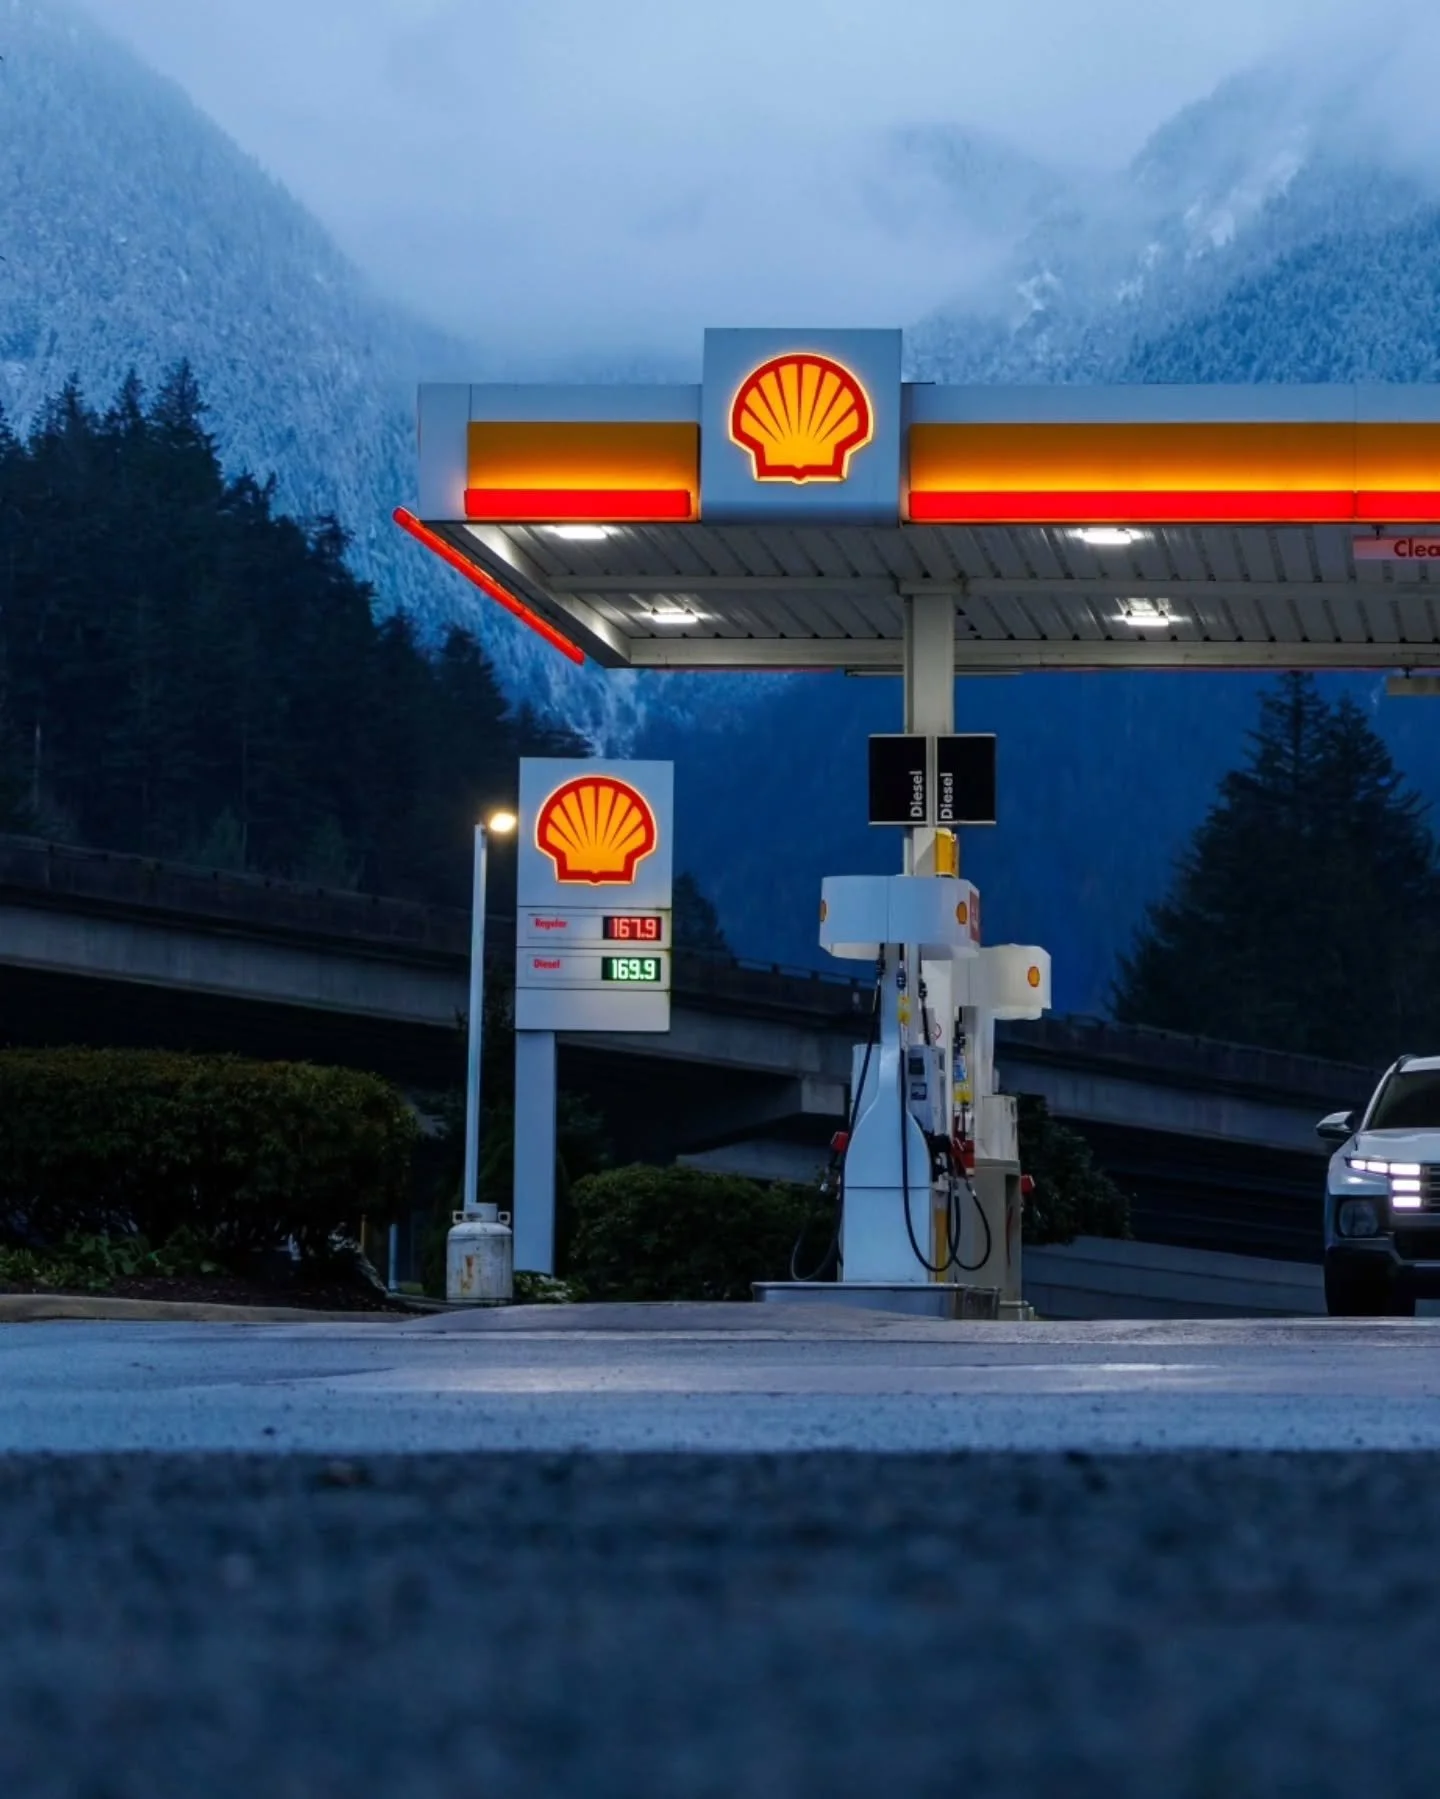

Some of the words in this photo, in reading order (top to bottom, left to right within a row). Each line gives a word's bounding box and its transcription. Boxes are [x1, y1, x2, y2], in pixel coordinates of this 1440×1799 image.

[1394, 538, 1440, 557] Clea
[909, 770, 923, 817] Diesel
[940, 772, 953, 819] Diesel
[613, 918, 656, 938] 167.9
[534, 959, 560, 969] Diesel
[612, 958, 656, 980] 169.9
